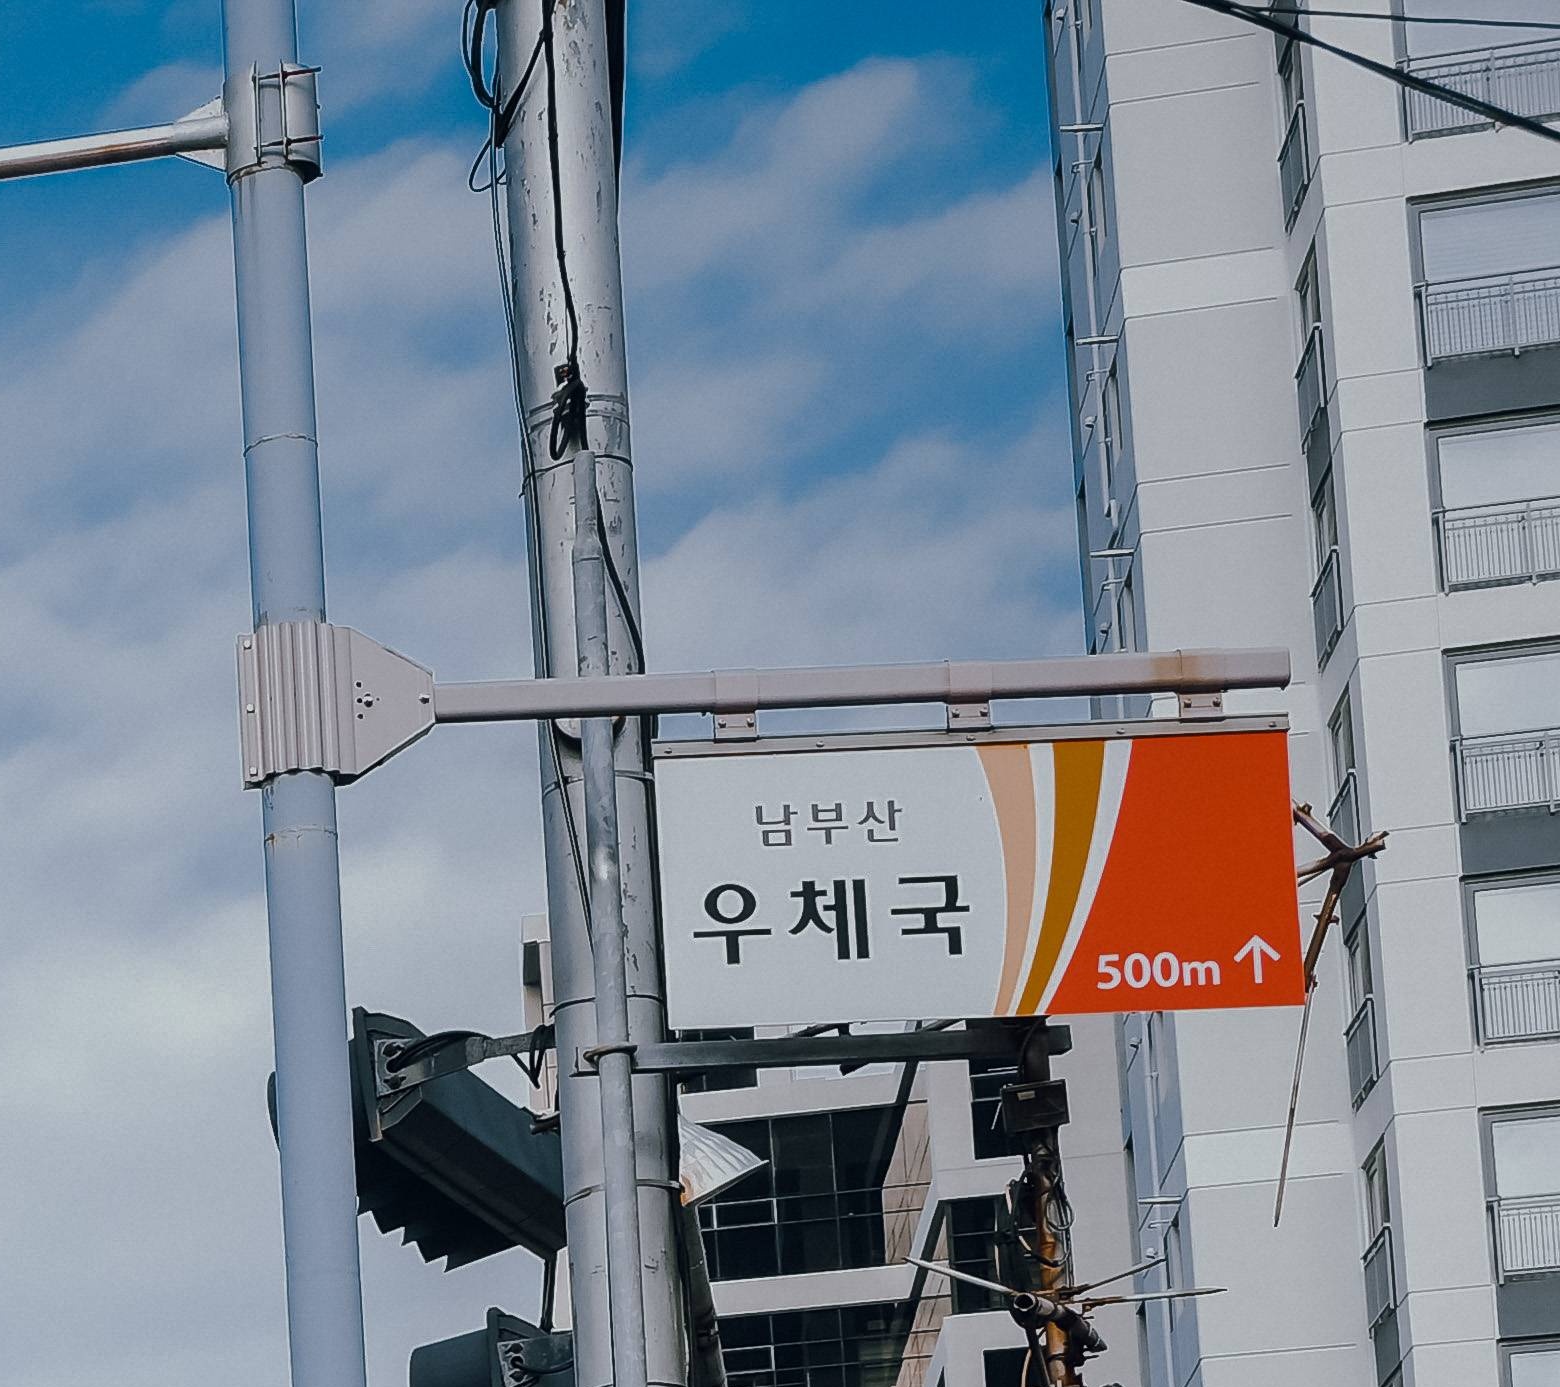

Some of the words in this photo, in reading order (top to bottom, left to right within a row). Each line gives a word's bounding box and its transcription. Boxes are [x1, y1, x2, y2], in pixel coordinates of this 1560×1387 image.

[755, 799, 903, 847] 남부산
[692, 874, 971, 966] 우체국
[1097, 951, 1220, 990] 500m
